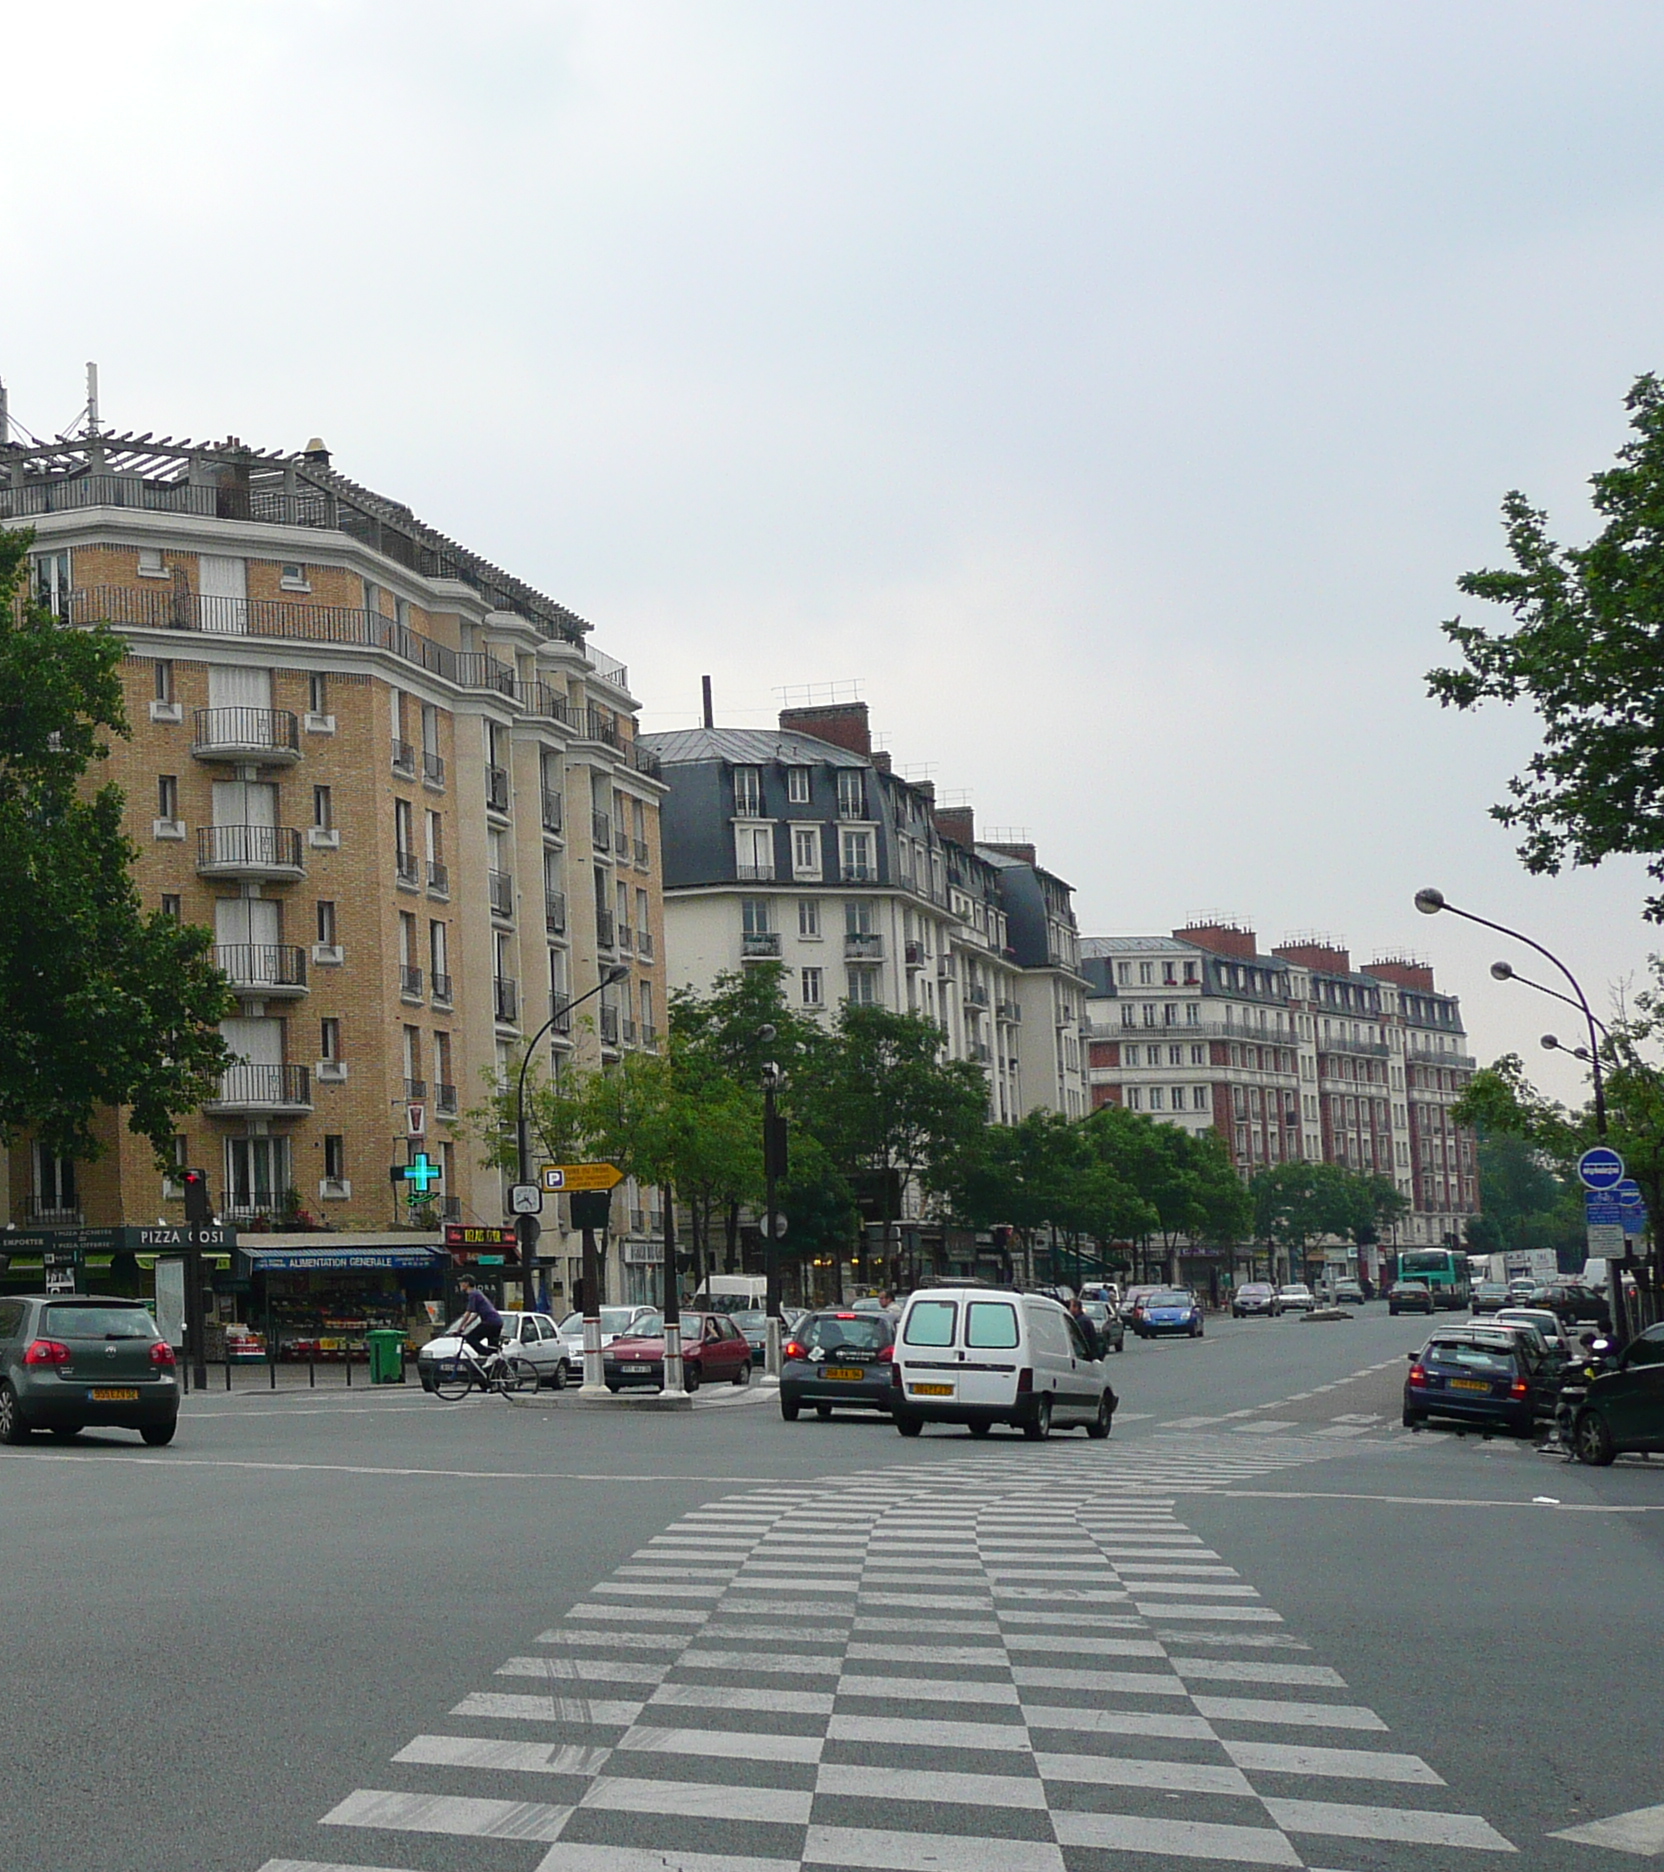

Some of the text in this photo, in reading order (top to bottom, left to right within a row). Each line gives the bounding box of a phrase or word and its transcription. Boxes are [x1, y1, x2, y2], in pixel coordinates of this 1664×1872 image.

[141, 1230, 181, 1244] PIZZA
[289, 1257, 347, 1268] ALIMENTATION
[349, 1257, 392, 1267] GENERALE
